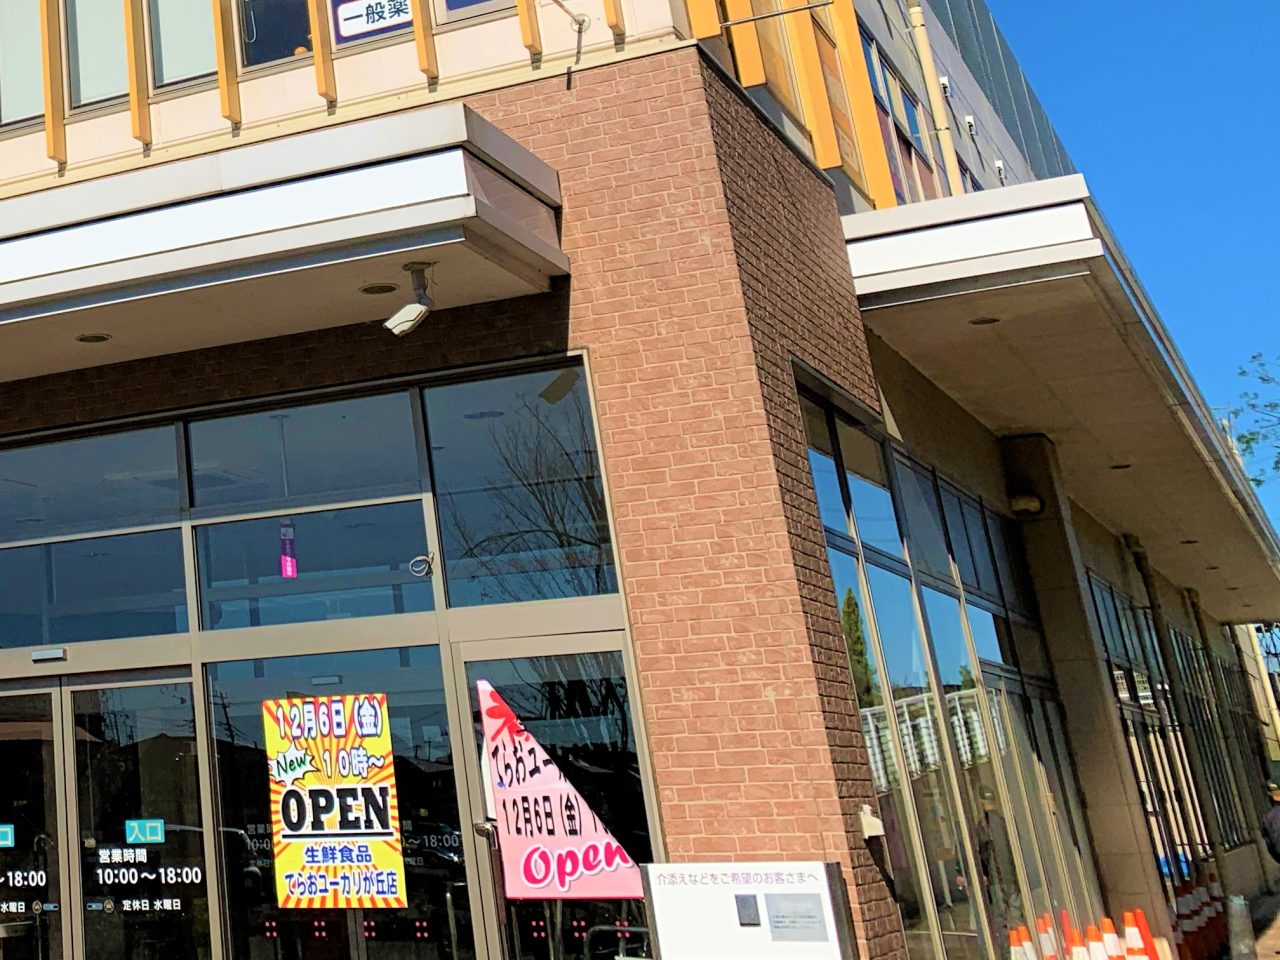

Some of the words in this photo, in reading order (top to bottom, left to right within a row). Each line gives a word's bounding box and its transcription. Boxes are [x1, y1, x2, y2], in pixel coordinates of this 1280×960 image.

[276, 751, 307, 778] New
[281, 787, 390, 832] OPEN
[128, 822, 161, 842] 入口
[99, 848, 147, 863] 営業時間
[304, 845, 372, 864] 生鮮食品
[523, 841, 631, 889] Open
[284, 871, 398, 897] てらおユーカリが丘店
[656, 871, 819, 886] 介添えなどをご希望のお客さまへ
[0, 901, 25, 913] 水曜日
[122, 899, 150, 911] 定休日
[153, 898, 181, 910] 水曜日
